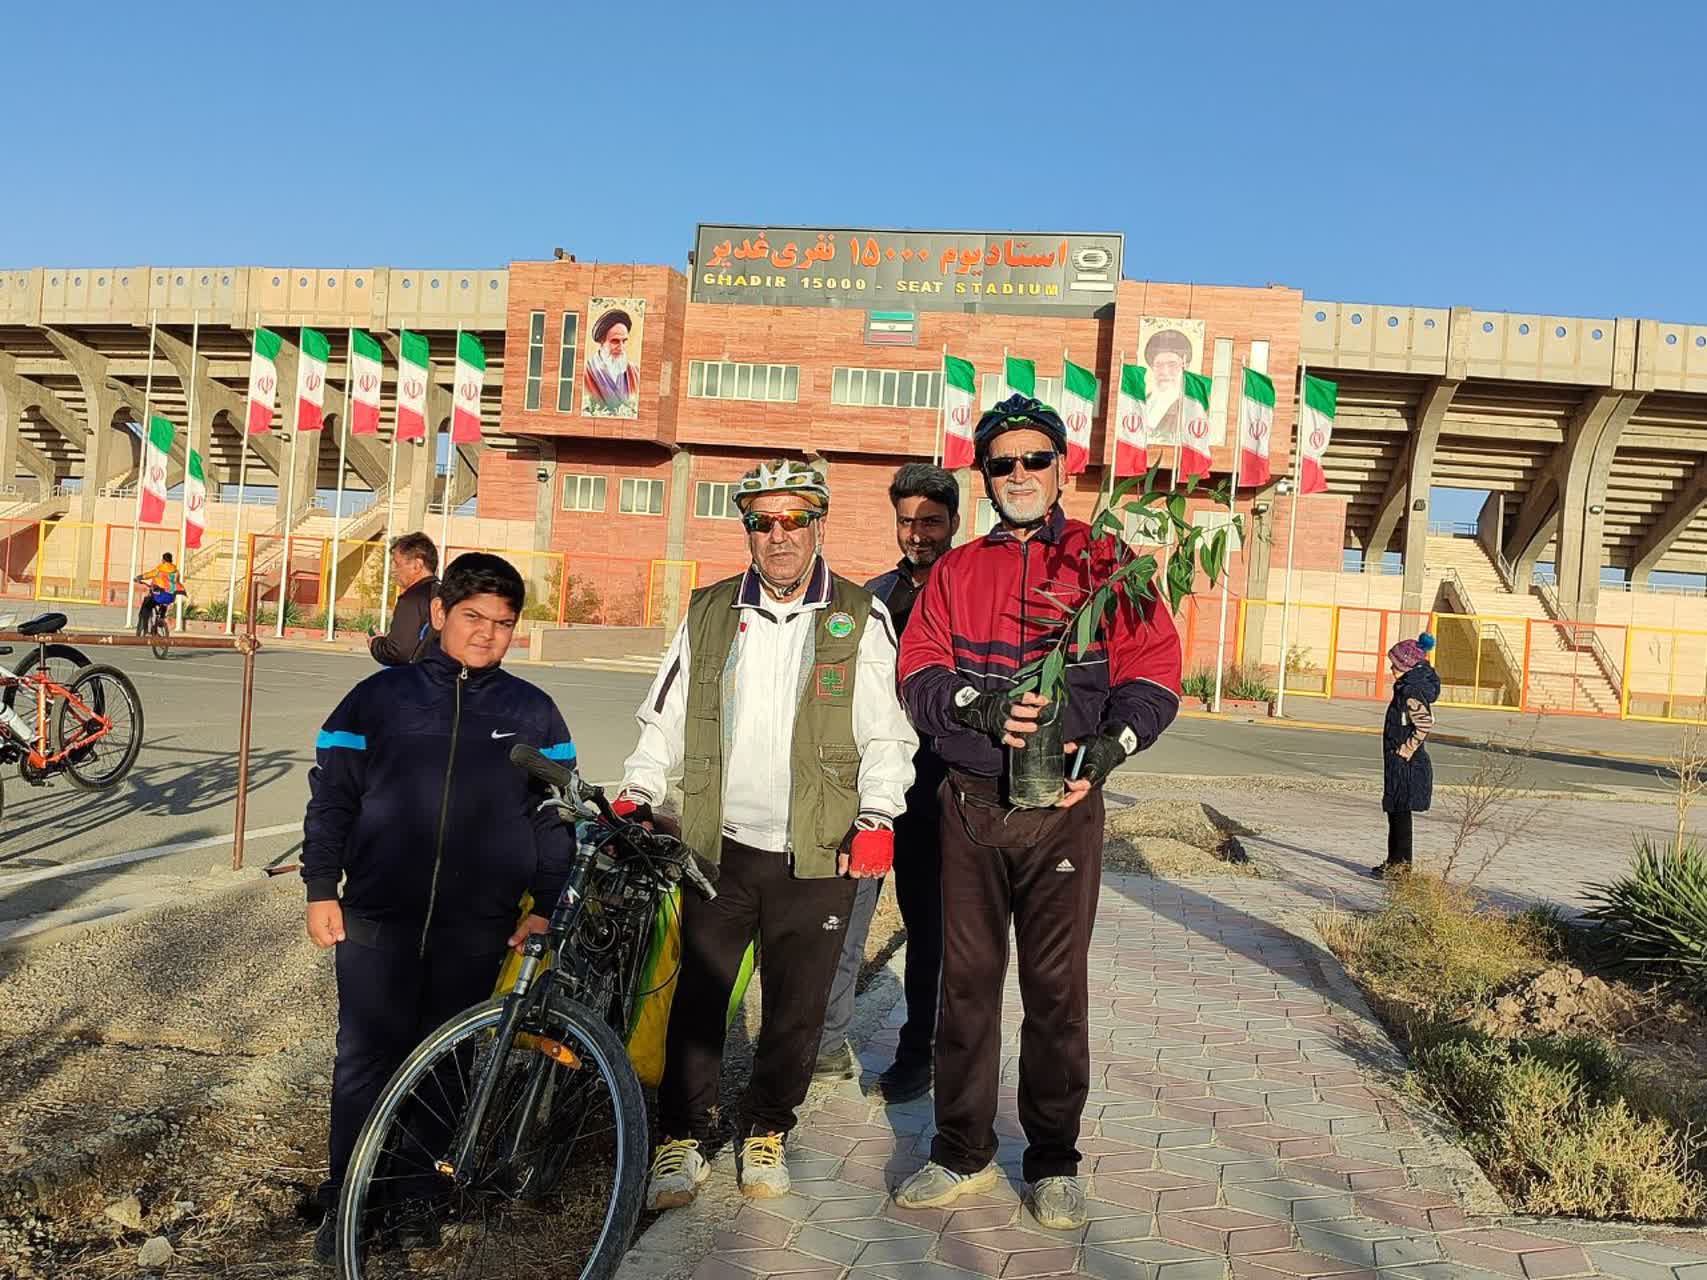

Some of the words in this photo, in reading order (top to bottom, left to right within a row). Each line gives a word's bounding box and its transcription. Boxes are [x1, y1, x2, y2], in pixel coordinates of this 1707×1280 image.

[705, 231, 770, 269] غدیر
[770, 233, 837, 270] نفری
[849, 236, 930, 268] ۱۵۰۰۰
[939, 239, 1069, 277] استادیوم
[703, 272, 787, 289] GHADIR
[800, 276, 867, 291] 15000
[895, 280, 944, 294] SEAT
[955, 281, 1060, 297] STADIUM
